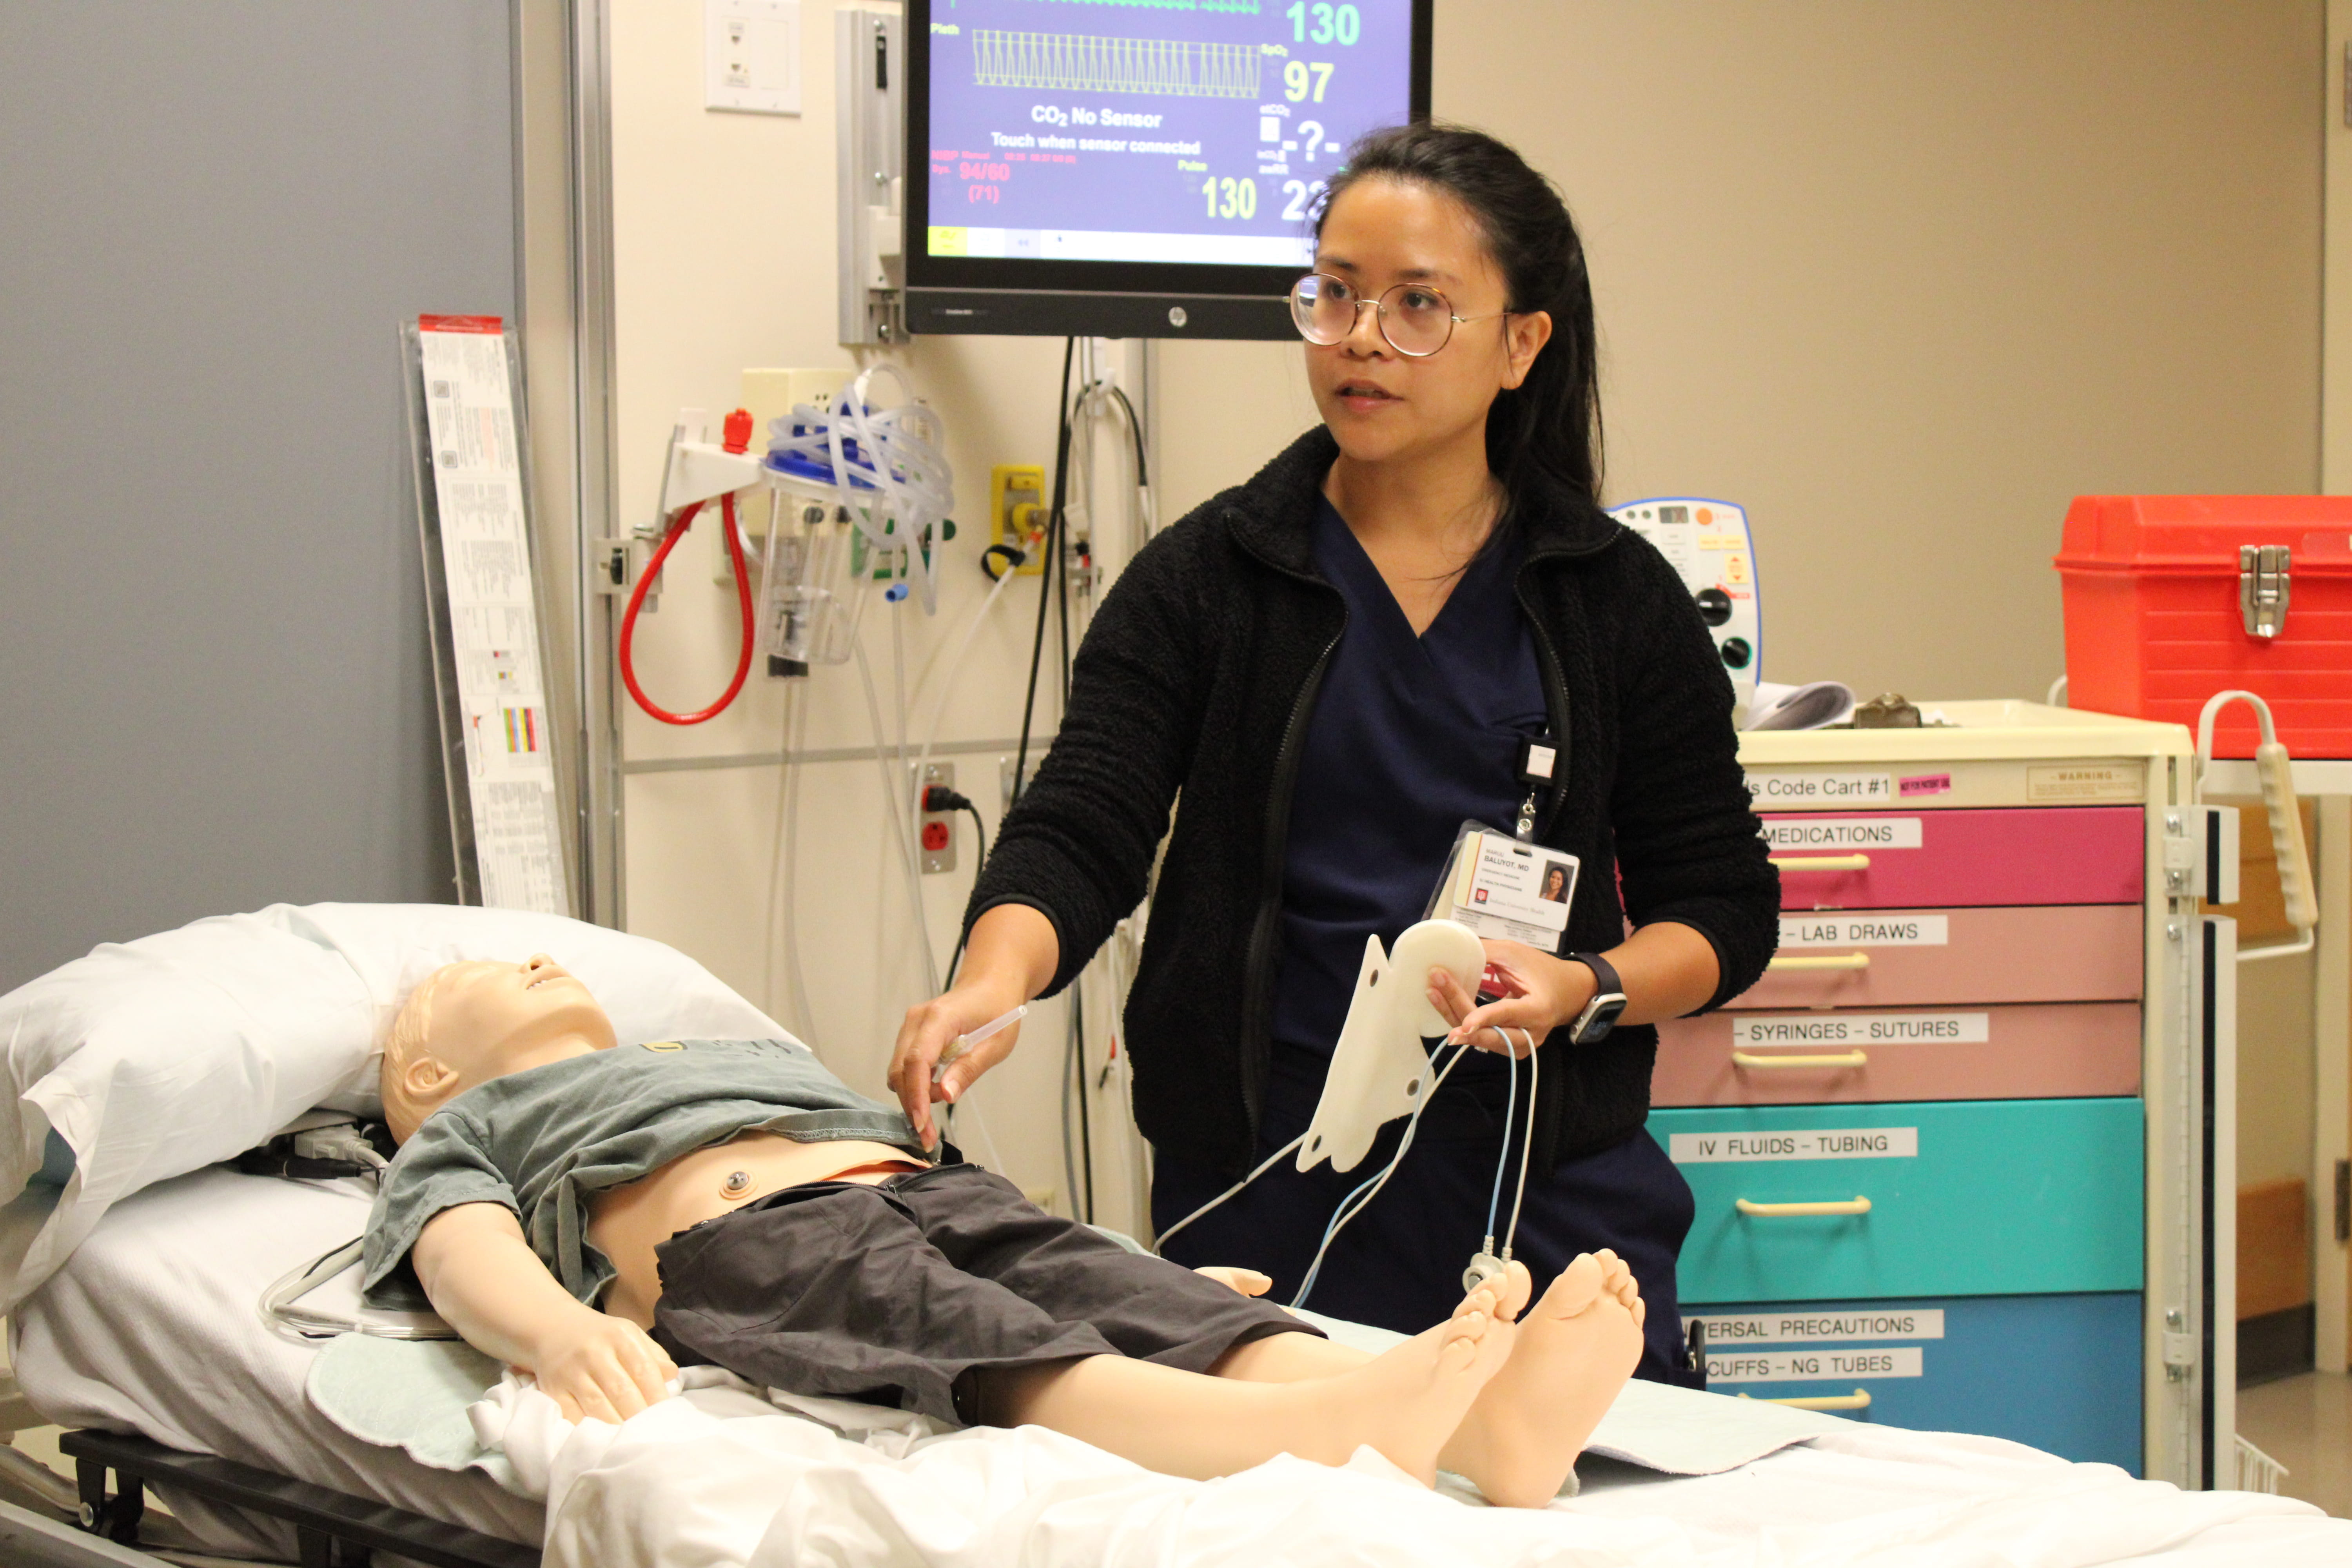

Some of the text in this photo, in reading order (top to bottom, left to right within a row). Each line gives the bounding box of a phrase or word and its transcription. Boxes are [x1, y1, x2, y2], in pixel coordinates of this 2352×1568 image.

[930, 23, 960, 35] Pleth
[1287, 1, 1360, 45] 130
[1285, 61, 1334, 102] 97
[1031, 105, 1163, 128] CO2 No Sensor
[991, 132, 1200, 155] Touch when sensor connected
[960, 162, 1010, 181] 94/60
[1178, 160, 1208, 171] Pulse
[969, 185, 1000, 204] (71)
[1203, 176, 1257, 219] 130
[2059, 771, 2112, 780] WARNING
[1746, 779, 1760, 795] s
[1768, 779, 1816, 795] Code
[1823, 778, 1862, 795] Cart
[1868, 778, 1889, 794] #1
[1762, 826, 1893, 843] MEDICATIONS
[1802, 925, 1837, 941] LAB
[1849, 924, 1918, 940] DRAWS
[1751, 1023, 1847, 1041] SYRINGES
[1870, 1021, 1959, 1038] SUTURES
[1699, 1140, 1716, 1156] IV
[1728, 1138, 1795, 1155] FLUIDS
[1817, 1135, 1888, 1152] TUBING
[1781, 1317, 1915, 1335] PRECAUTIONS
[1707, 1359, 1769, 1377] CUFFS
[1792, 1358, 1819, 1374] NG
[1831, 1356, 1893, 1372] TUBES
